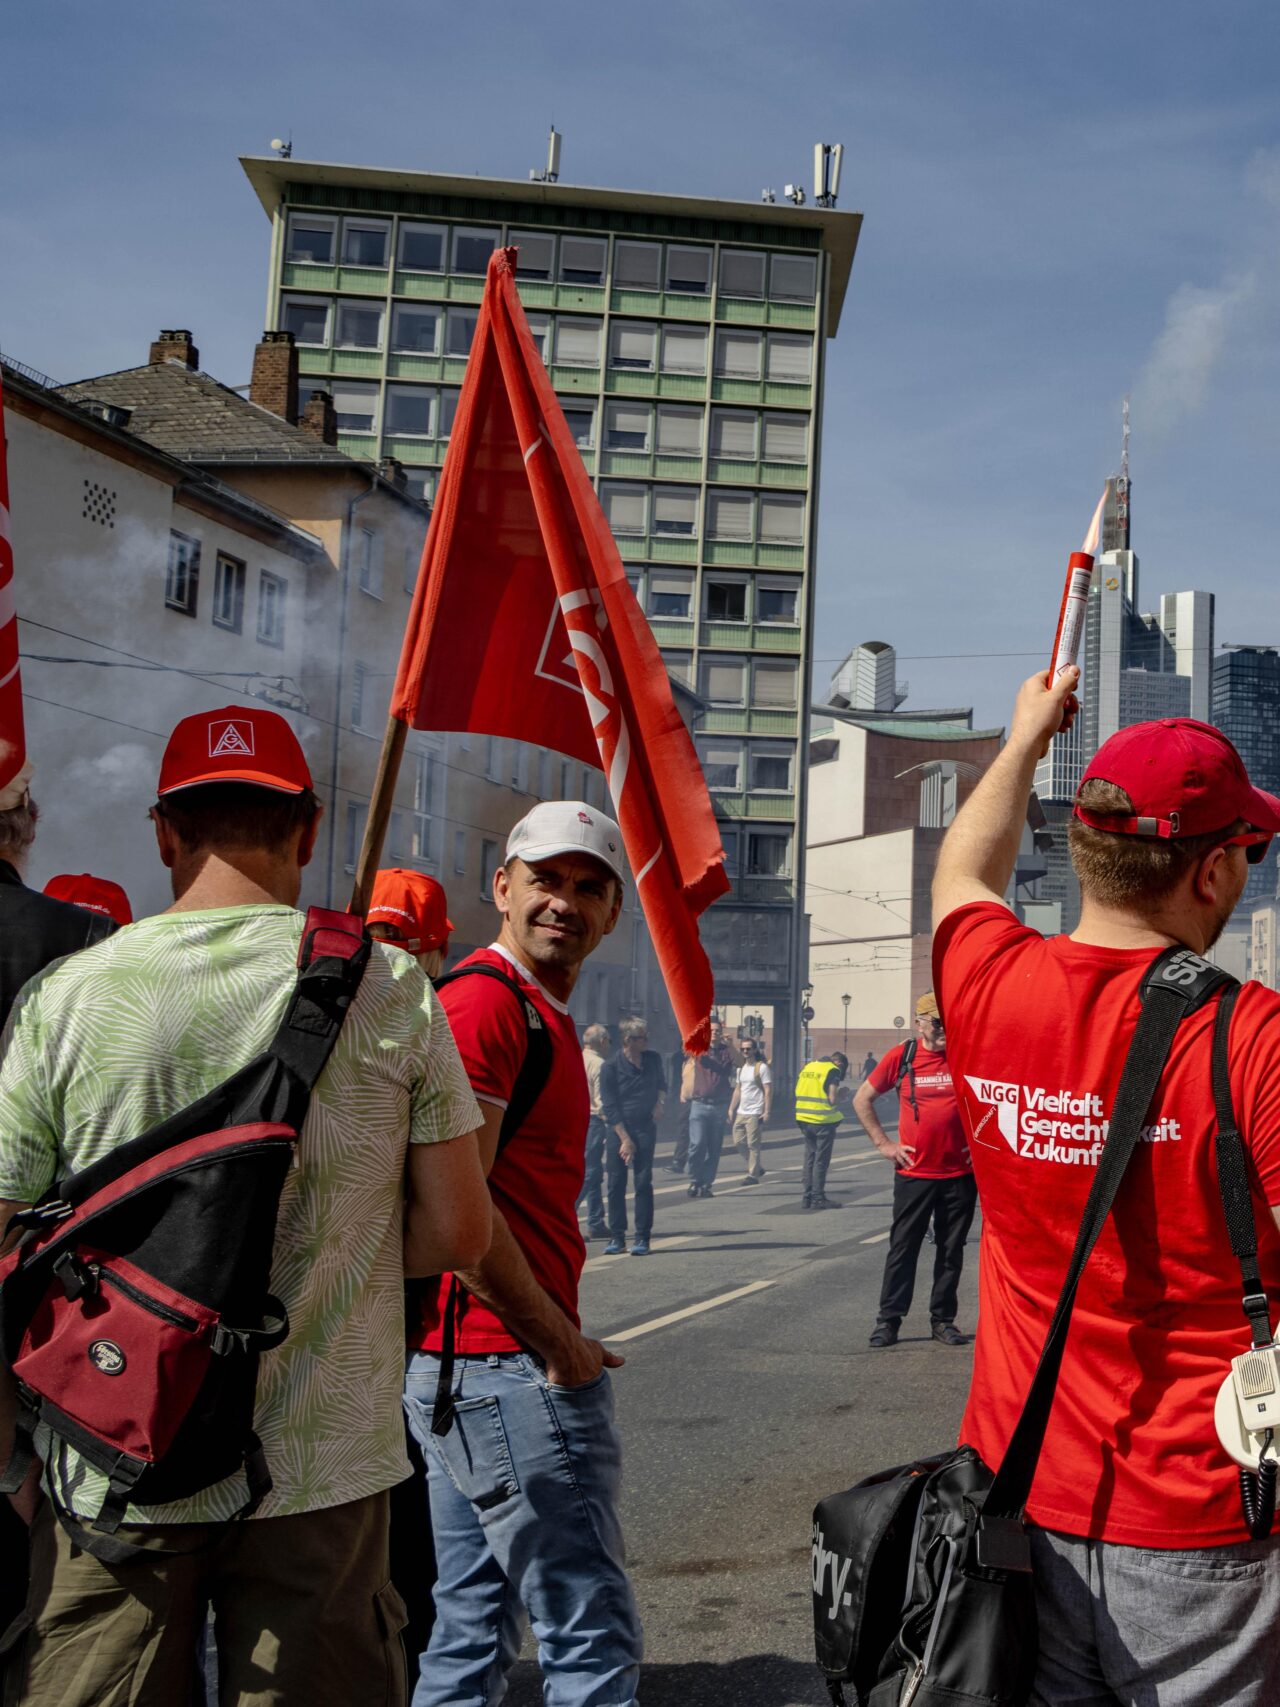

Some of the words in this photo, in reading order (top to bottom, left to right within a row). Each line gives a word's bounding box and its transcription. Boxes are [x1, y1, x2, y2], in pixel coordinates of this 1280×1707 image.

[980, 1082, 1017, 1104] NGG
[1022, 1085, 1104, 1118] Vielfalt
[1020, 1111, 1182, 1144] Gerechtkeit
[1020, 1134, 1106, 1167] Zukunf
